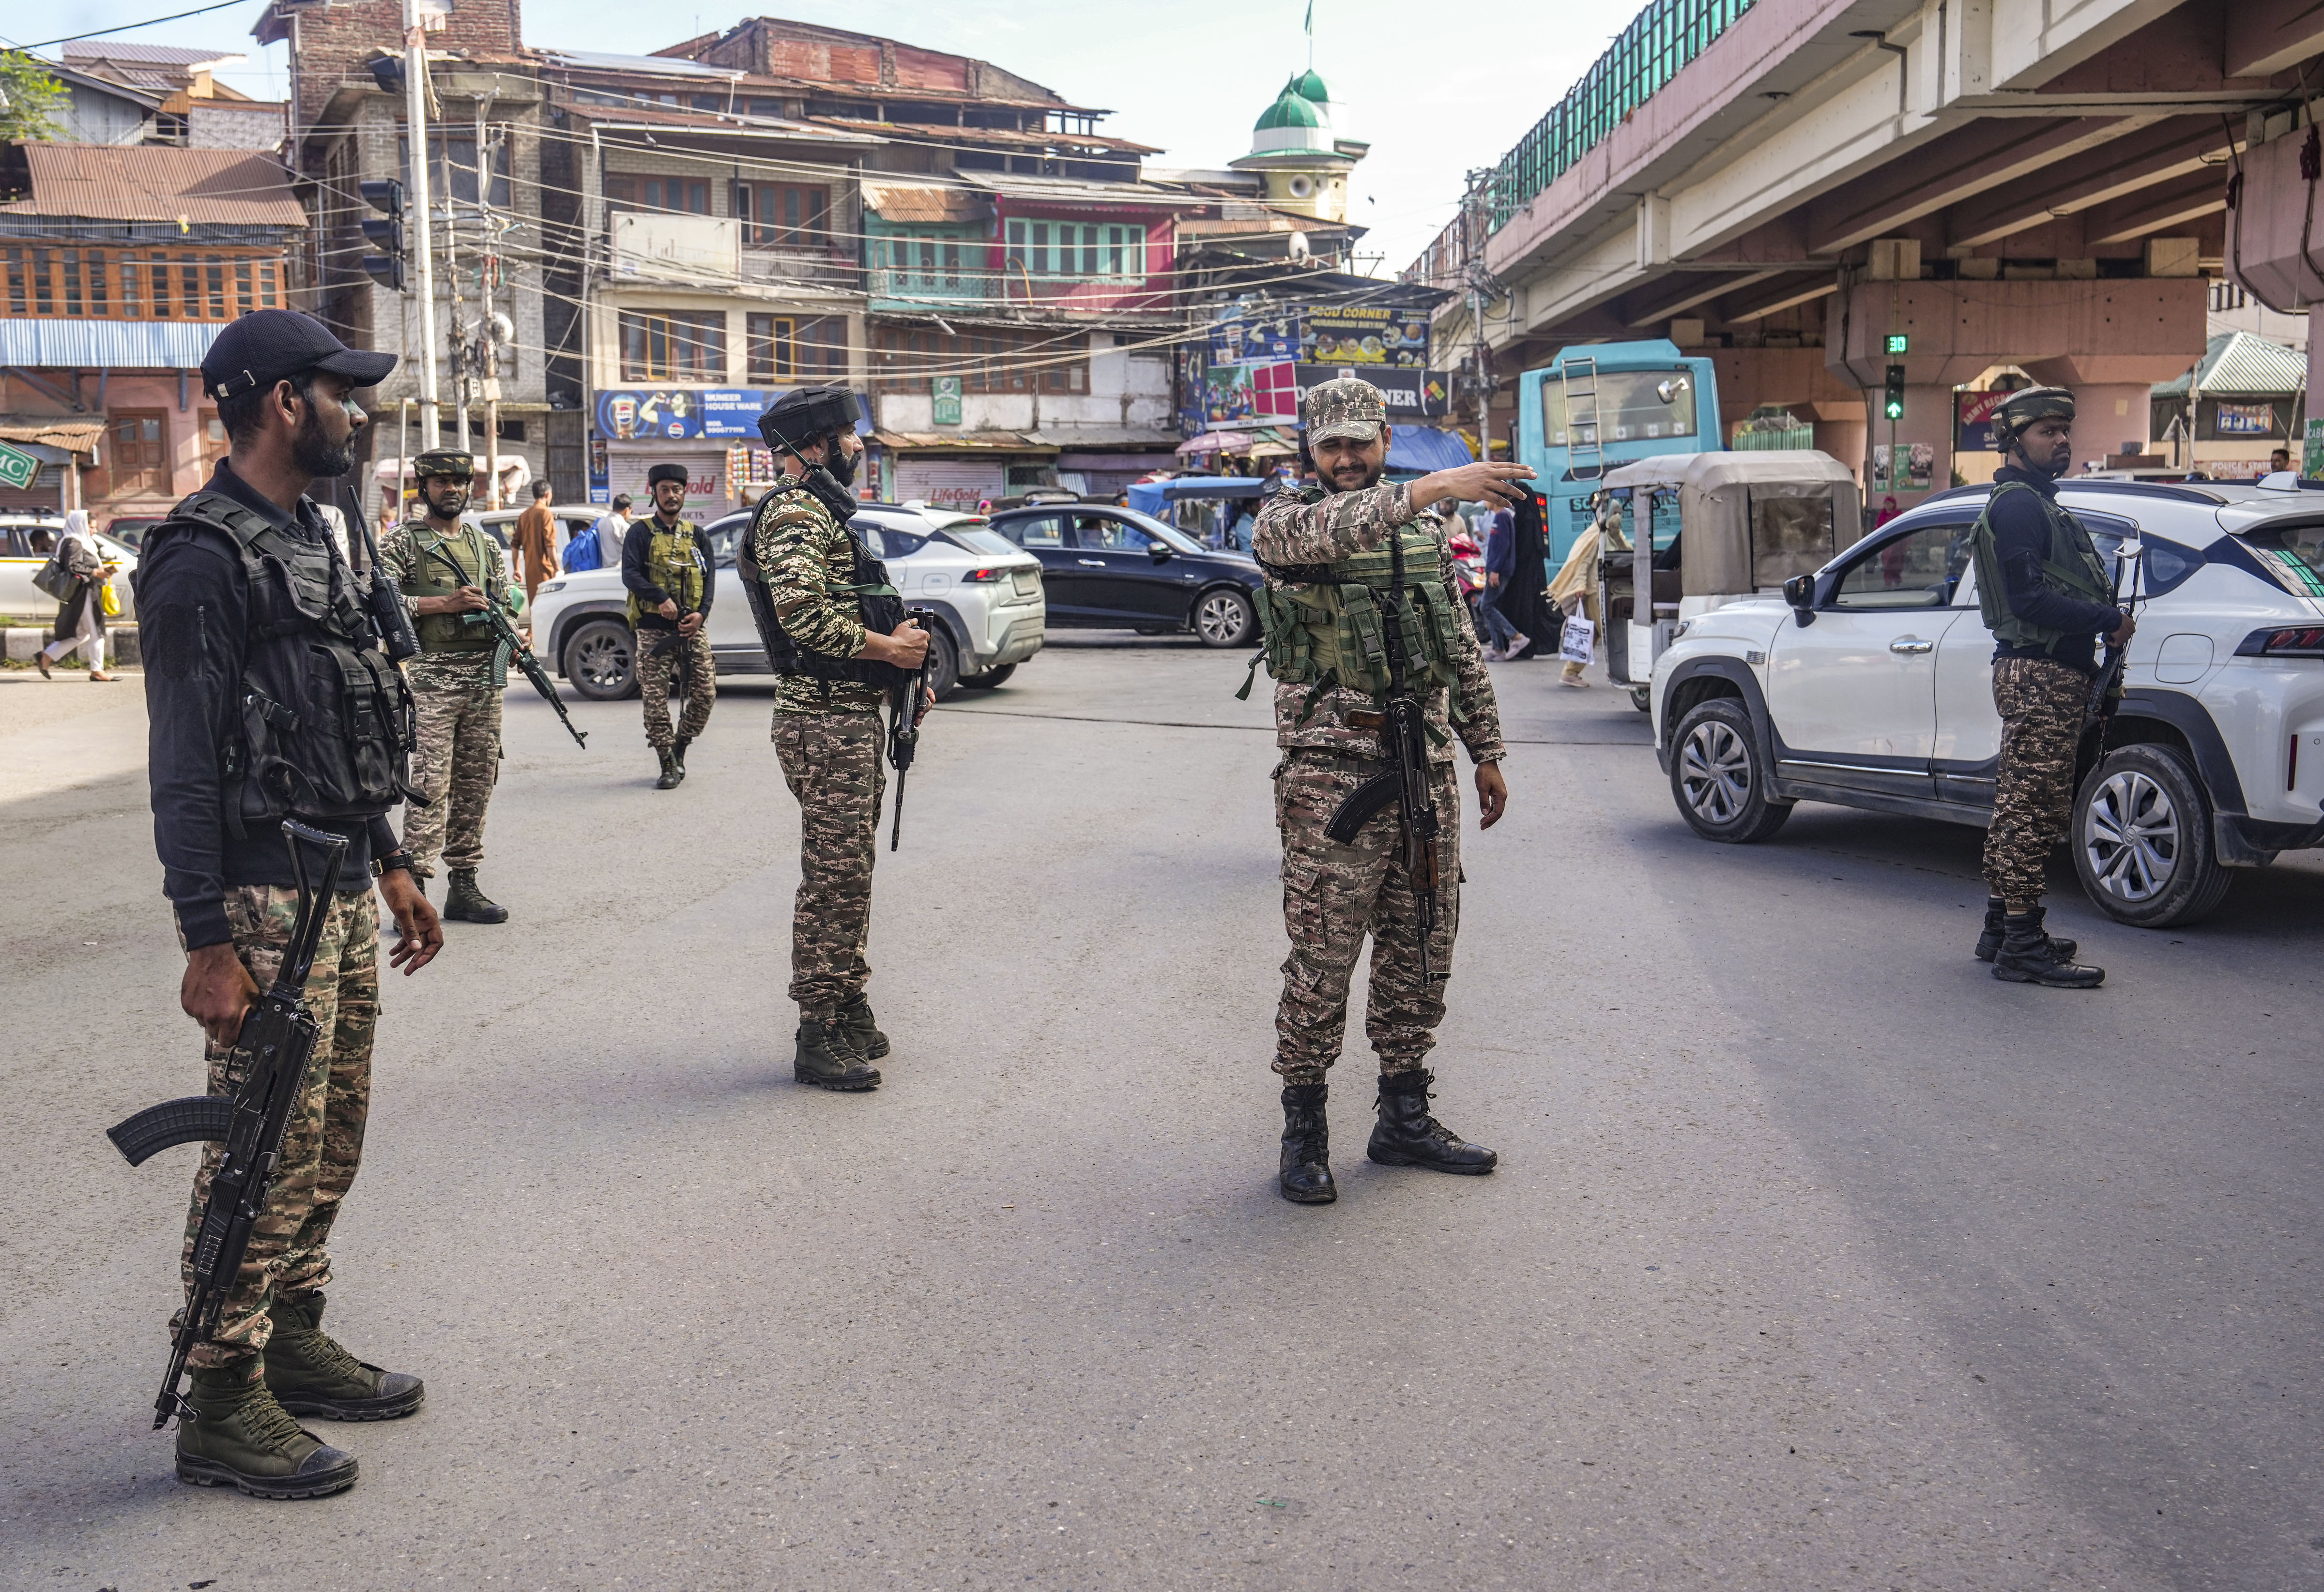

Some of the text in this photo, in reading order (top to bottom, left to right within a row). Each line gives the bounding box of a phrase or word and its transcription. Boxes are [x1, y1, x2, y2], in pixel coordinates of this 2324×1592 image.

[1308, 306, 1341, 318] FOOD
[1342, 307, 1391, 320] CORNER
[1889, 336, 1906, 352] 30
[704, 393, 742, 402] MUNEER
[705, 402, 763, 411] HOUSE WARE
[1963, 403, 1984, 426] ARMY
[2212, 461, 2243, 470] POLICE
